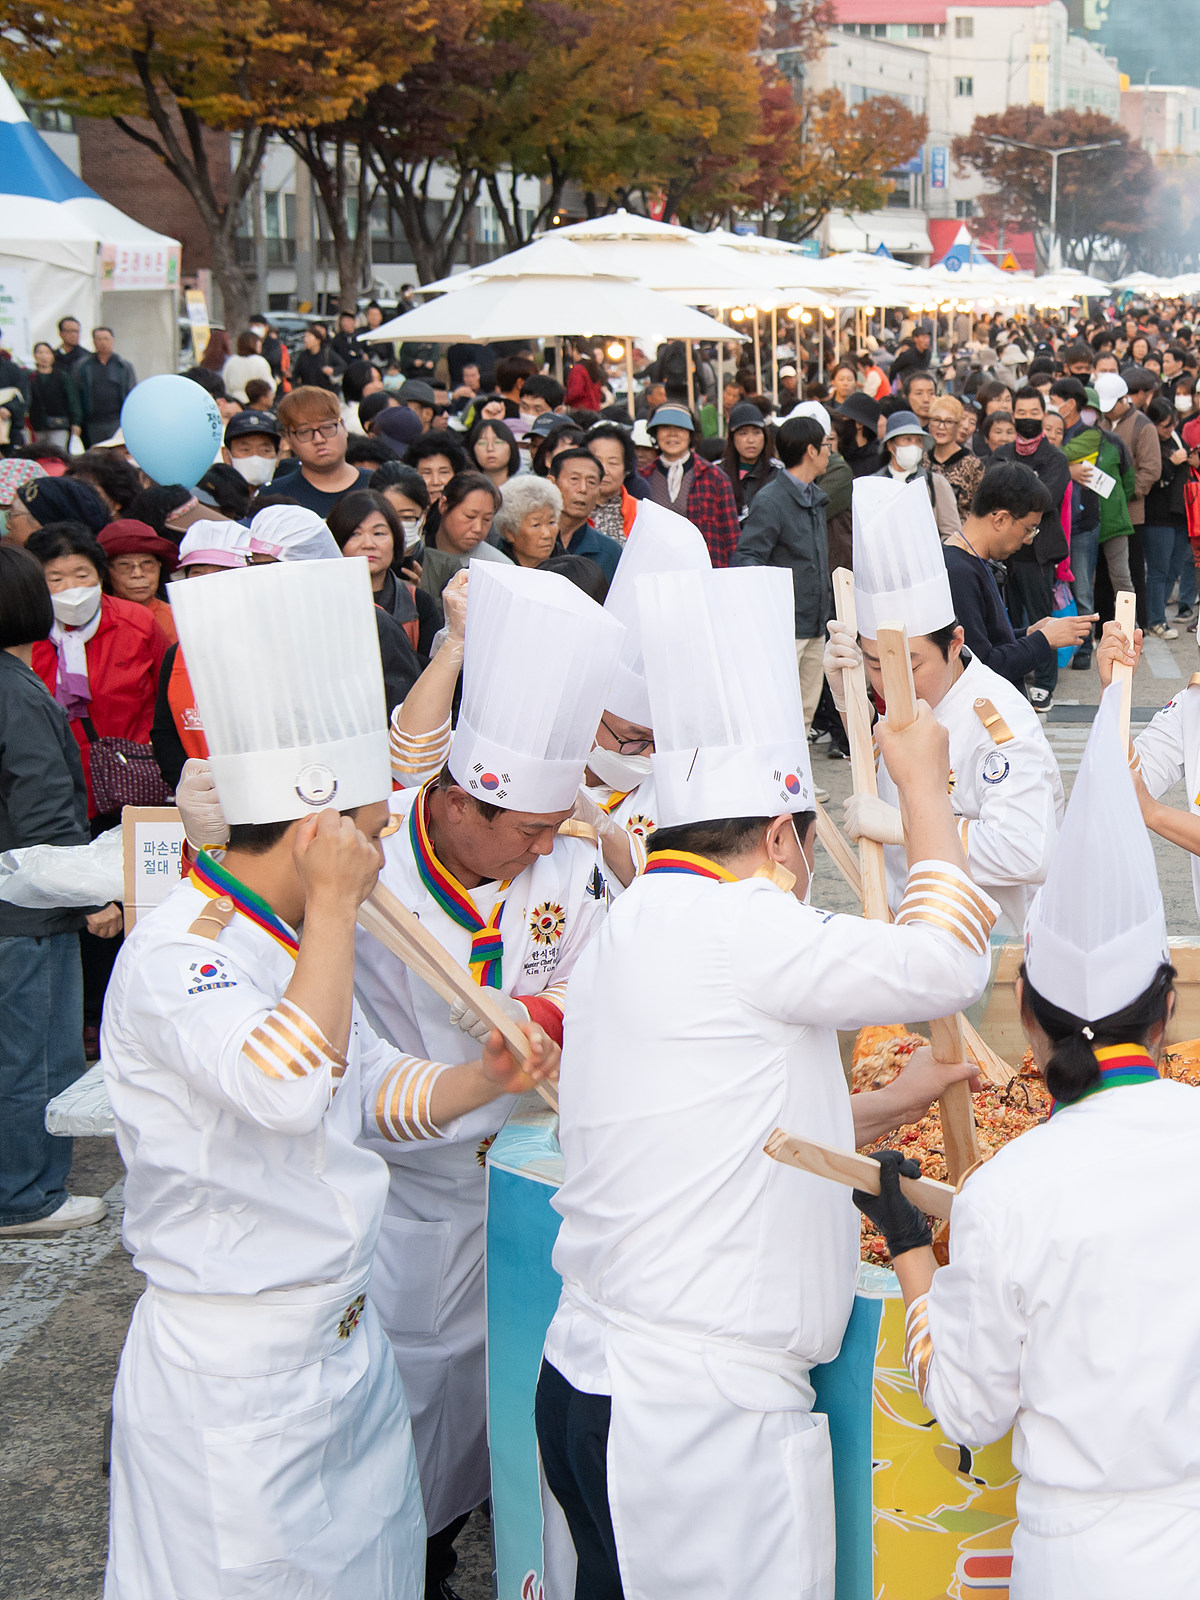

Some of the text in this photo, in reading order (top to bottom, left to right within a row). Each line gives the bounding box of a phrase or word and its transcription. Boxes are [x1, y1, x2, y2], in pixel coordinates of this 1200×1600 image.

[144, 860, 169, 875] 절대
[525, 968, 540, 976] Kim
[192, 982, 234, 994] KOREA
